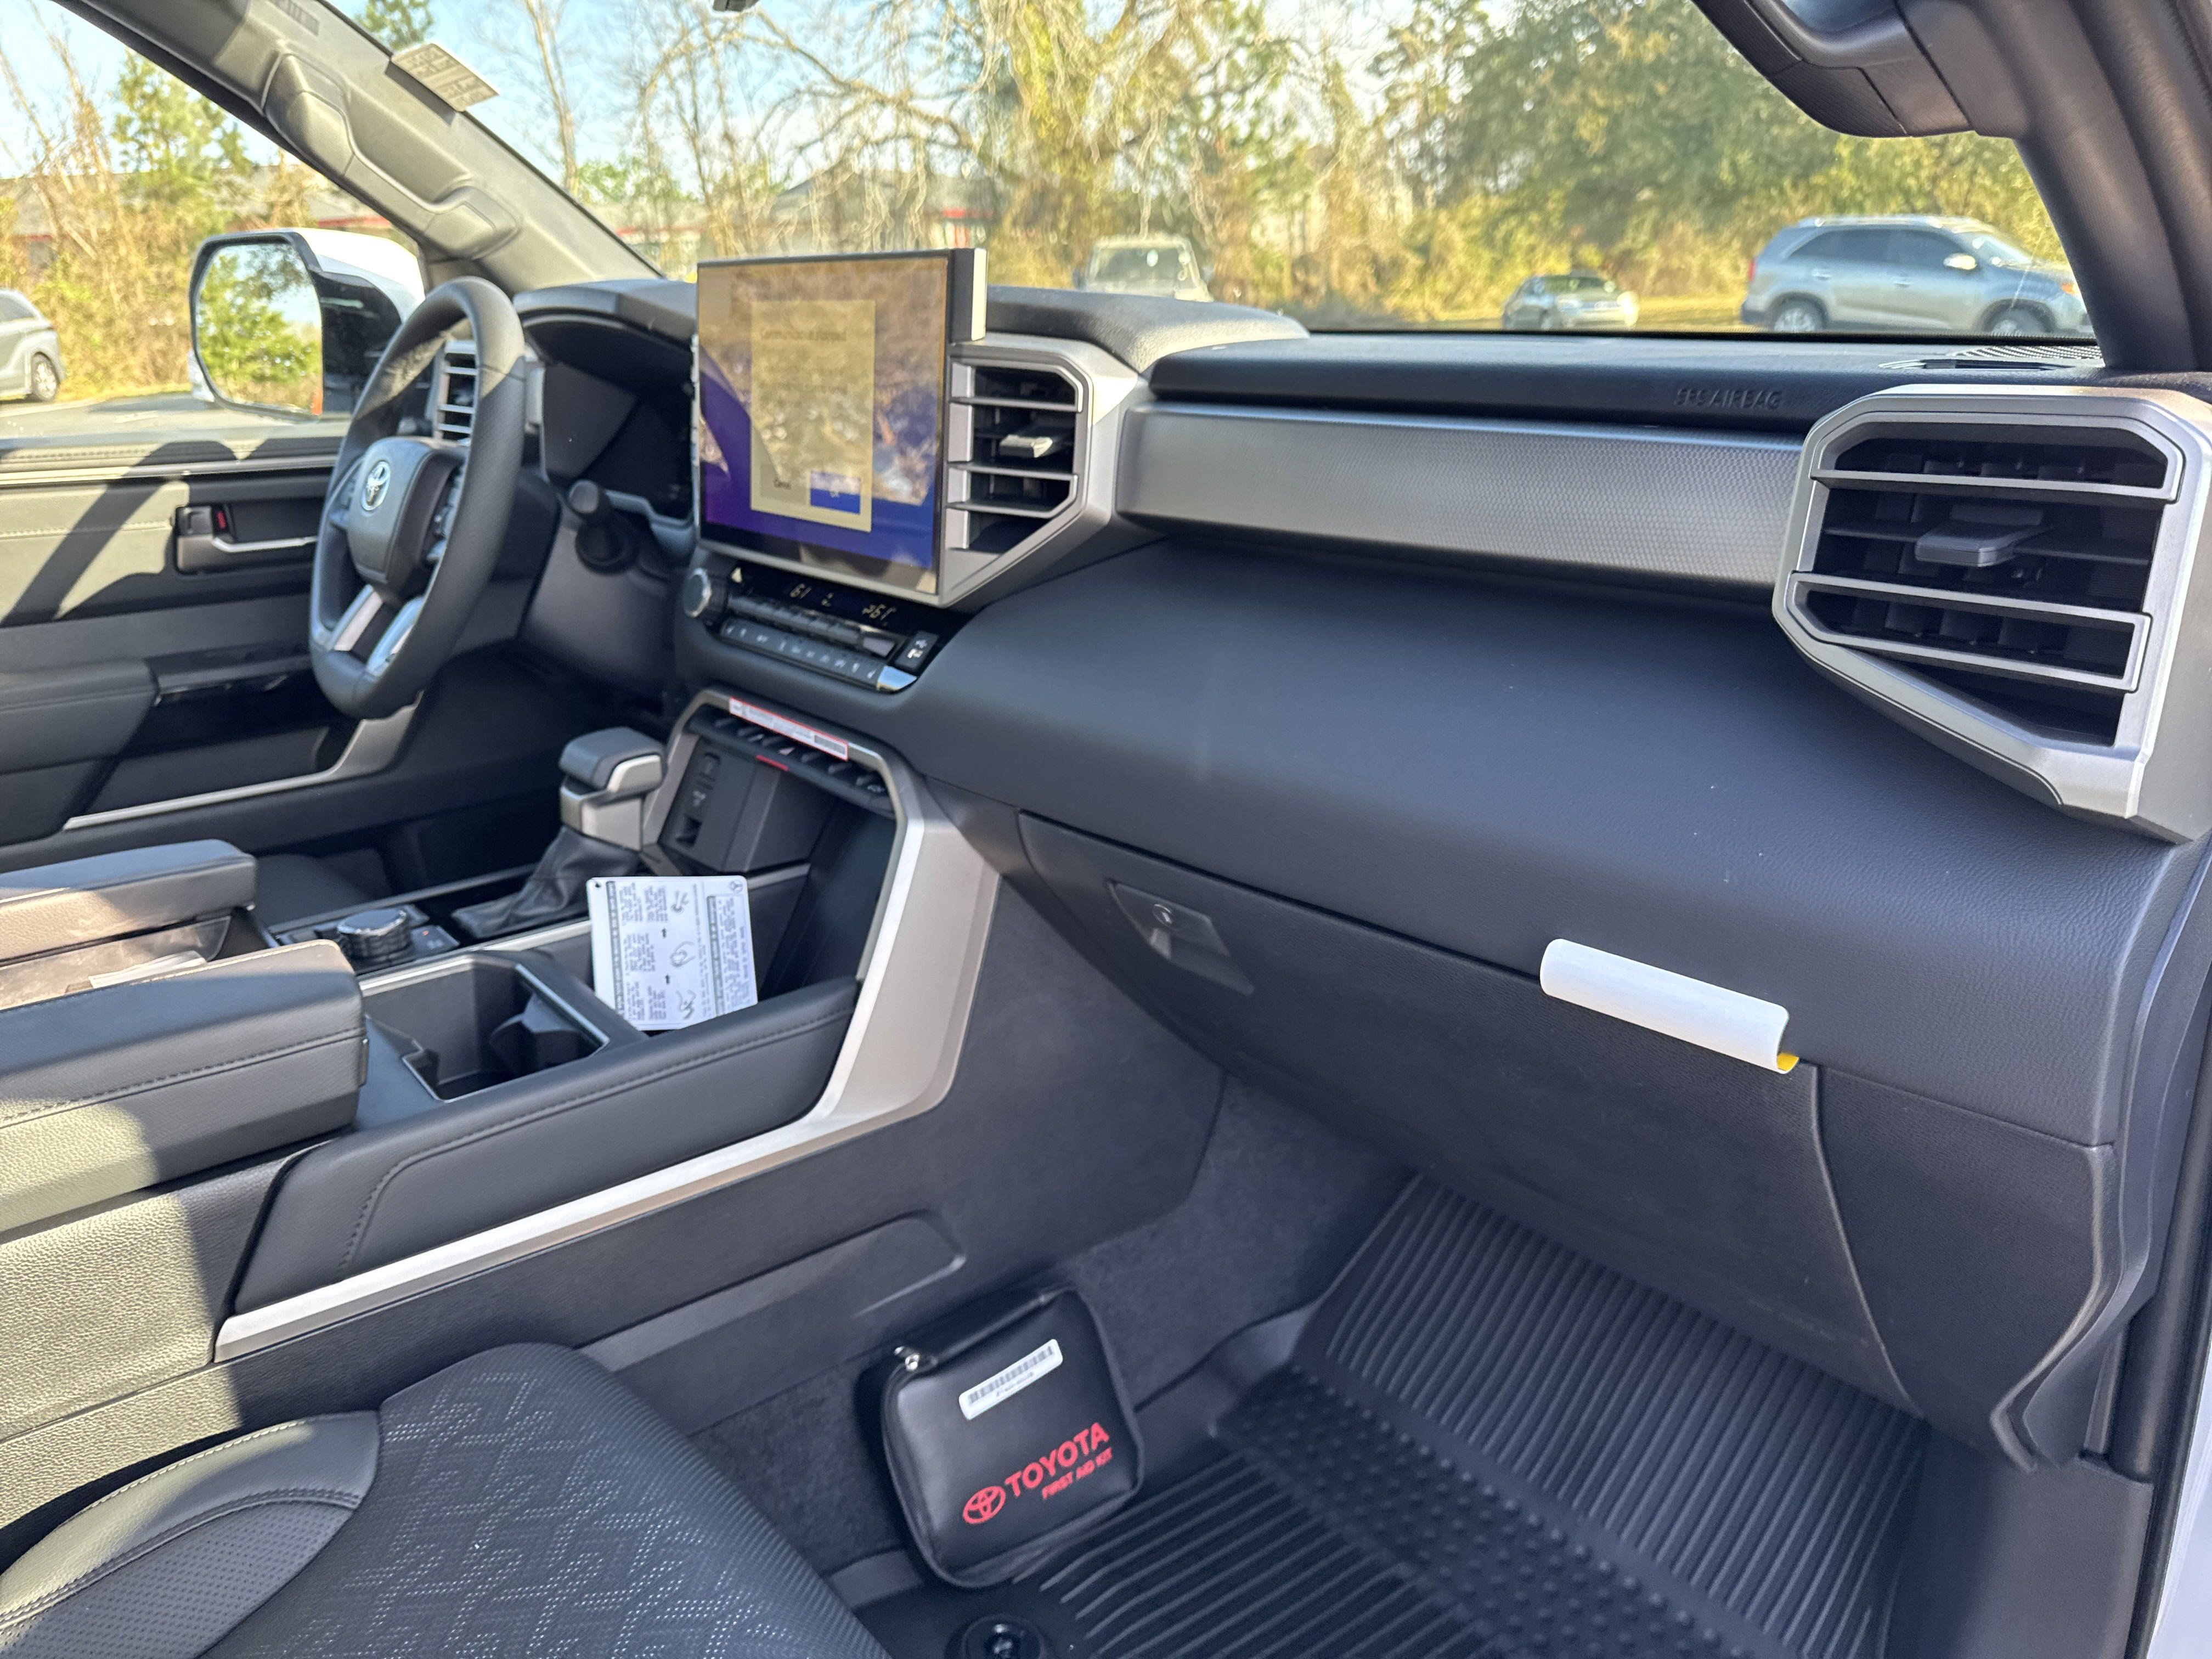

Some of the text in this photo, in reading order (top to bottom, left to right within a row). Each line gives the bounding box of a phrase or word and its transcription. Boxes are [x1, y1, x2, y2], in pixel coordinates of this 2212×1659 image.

[1708, 388, 1783, 410] AIRBAG
[1005, 1422, 1109, 1497] TOYOTA
[1076, 1460, 1095, 1481] AID
